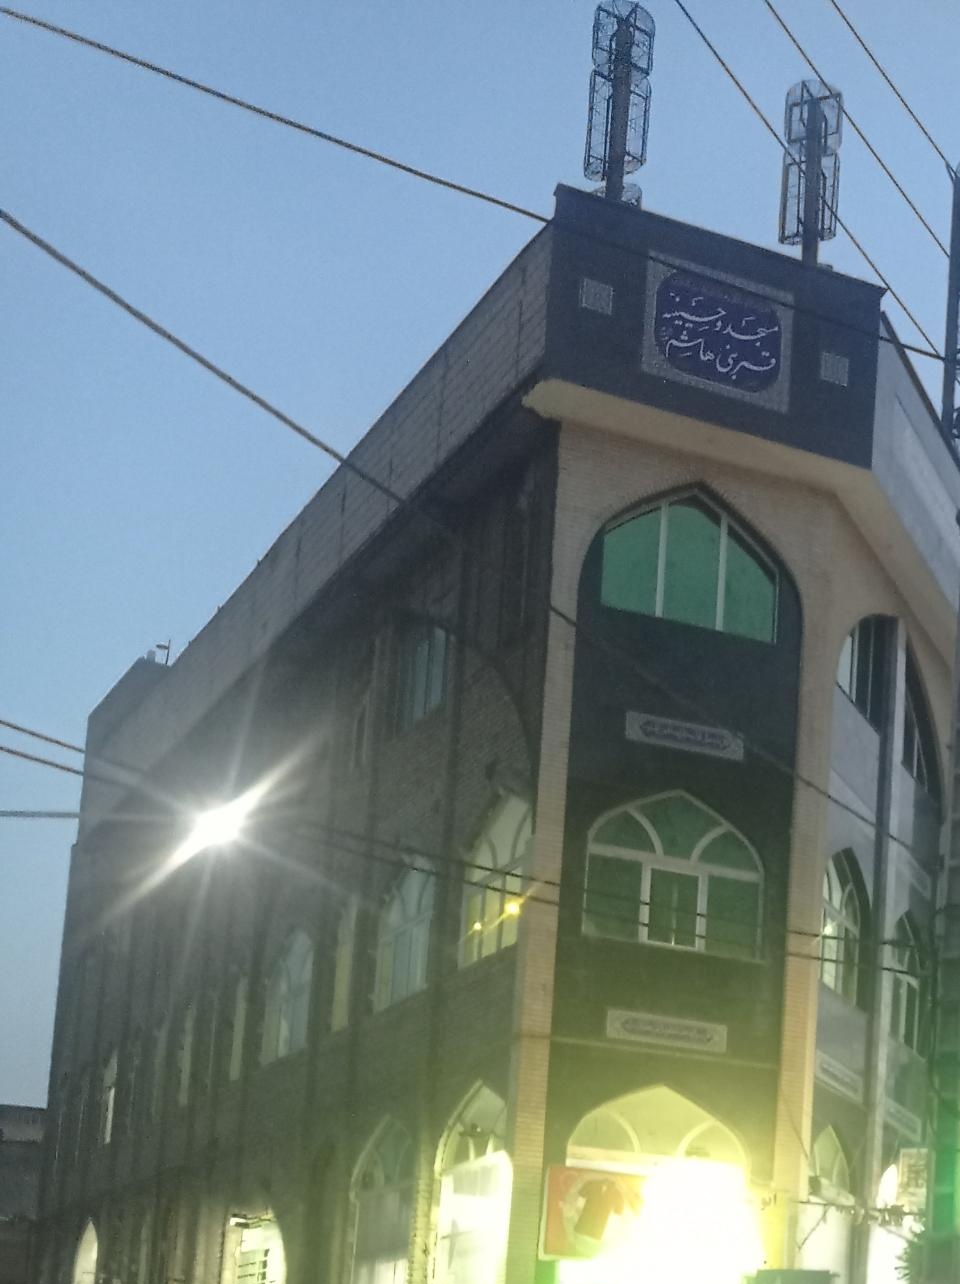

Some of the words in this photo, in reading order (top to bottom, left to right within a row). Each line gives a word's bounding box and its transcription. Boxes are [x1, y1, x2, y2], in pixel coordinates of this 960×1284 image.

[662, 292, 726, 331] حسینیه
[714, 320, 723, 331] و
[665, 330, 715, 360] هاشم
[722, 316, 779, 347] مسجد
